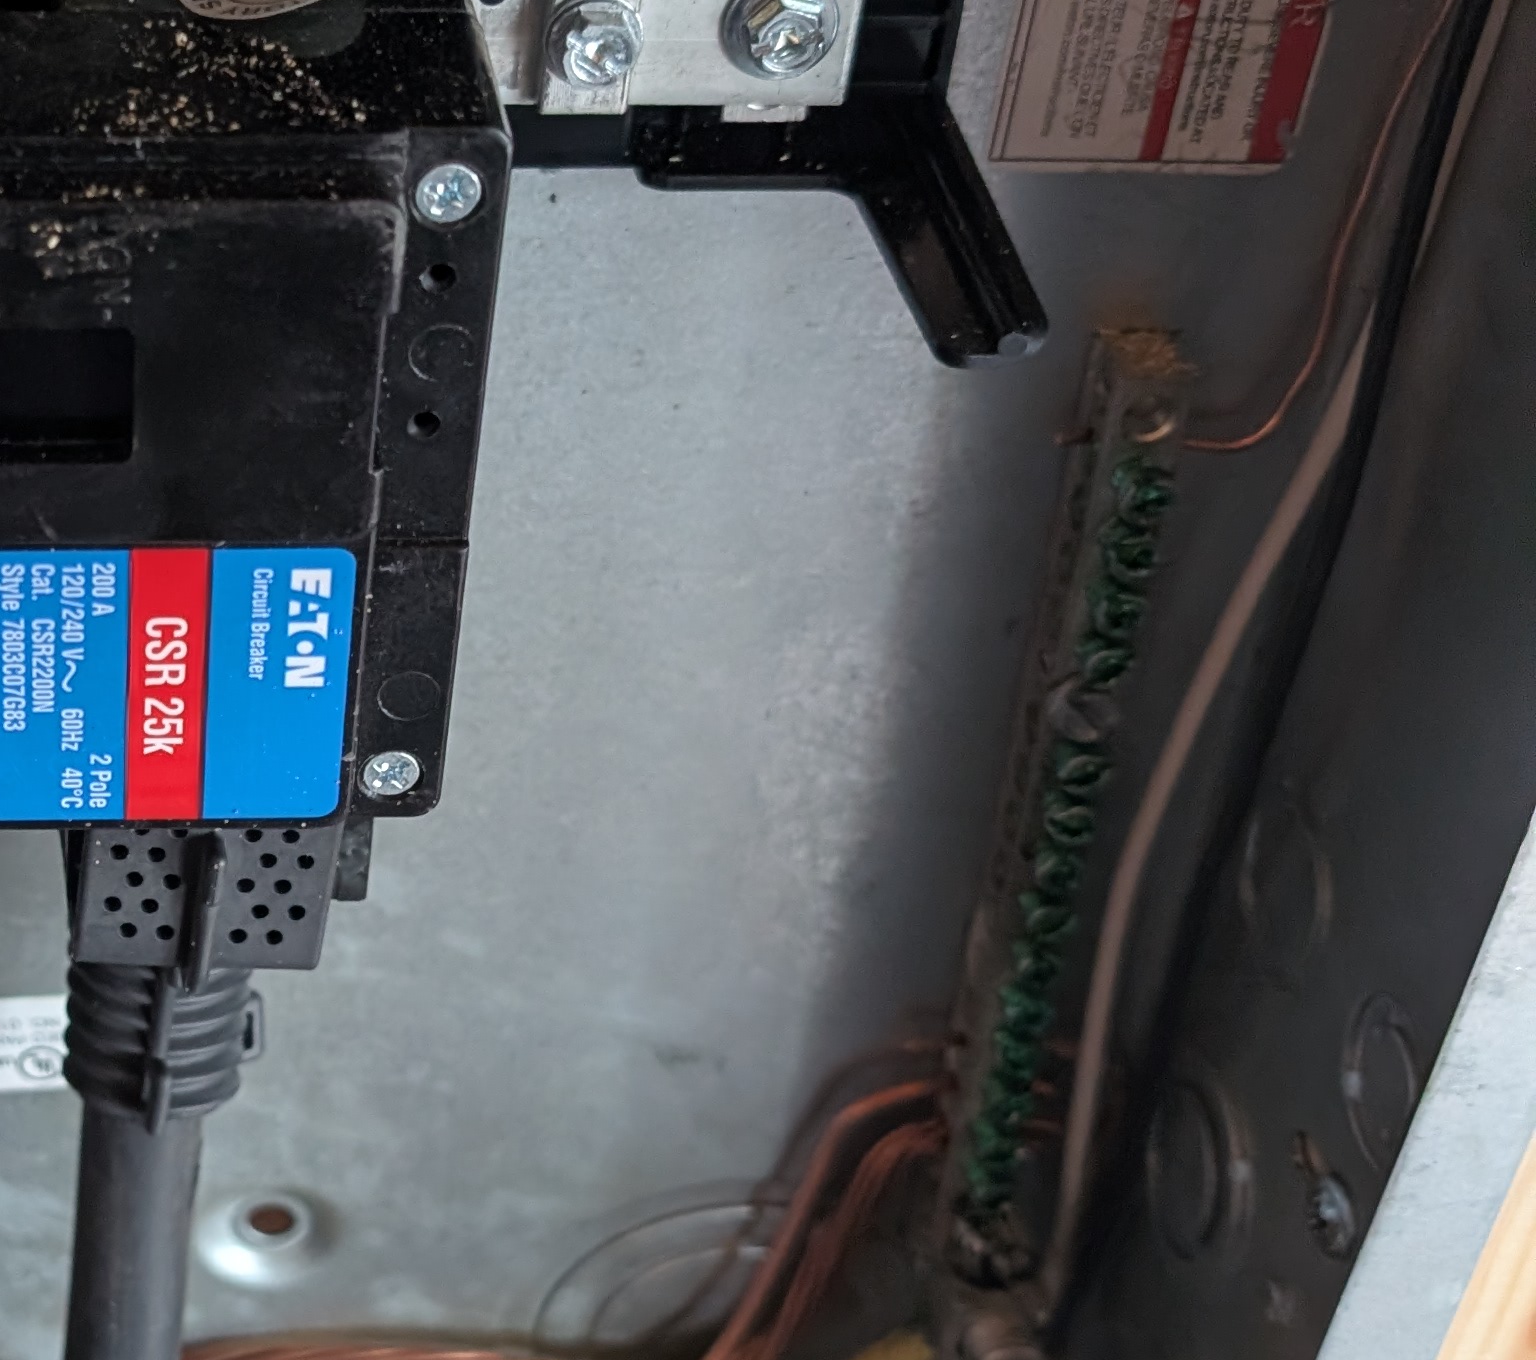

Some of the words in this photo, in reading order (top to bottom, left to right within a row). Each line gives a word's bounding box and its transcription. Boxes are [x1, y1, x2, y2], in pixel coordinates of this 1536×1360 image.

[31, 564, 56, 601] Cat.
[60, 563, 85, 643] 120/240
[91, 563, 116, 598] 200
[251, 568, 275, 619] Circuit
[91, 602, 116, 617] A
[283, 568, 333, 689] EATON
[31, 618, 56, 713] CSR2200N
[144, 617, 189, 687] CSR
[248, 622, 272, 681] Breaker
[61, 708, 85, 752] 60Hz
[143, 697, 185, 756] 25k
[88, 754, 113, 765] 2
[61, 768, 84, 809] 40°C
[88, 770, 113, 809] Pole
